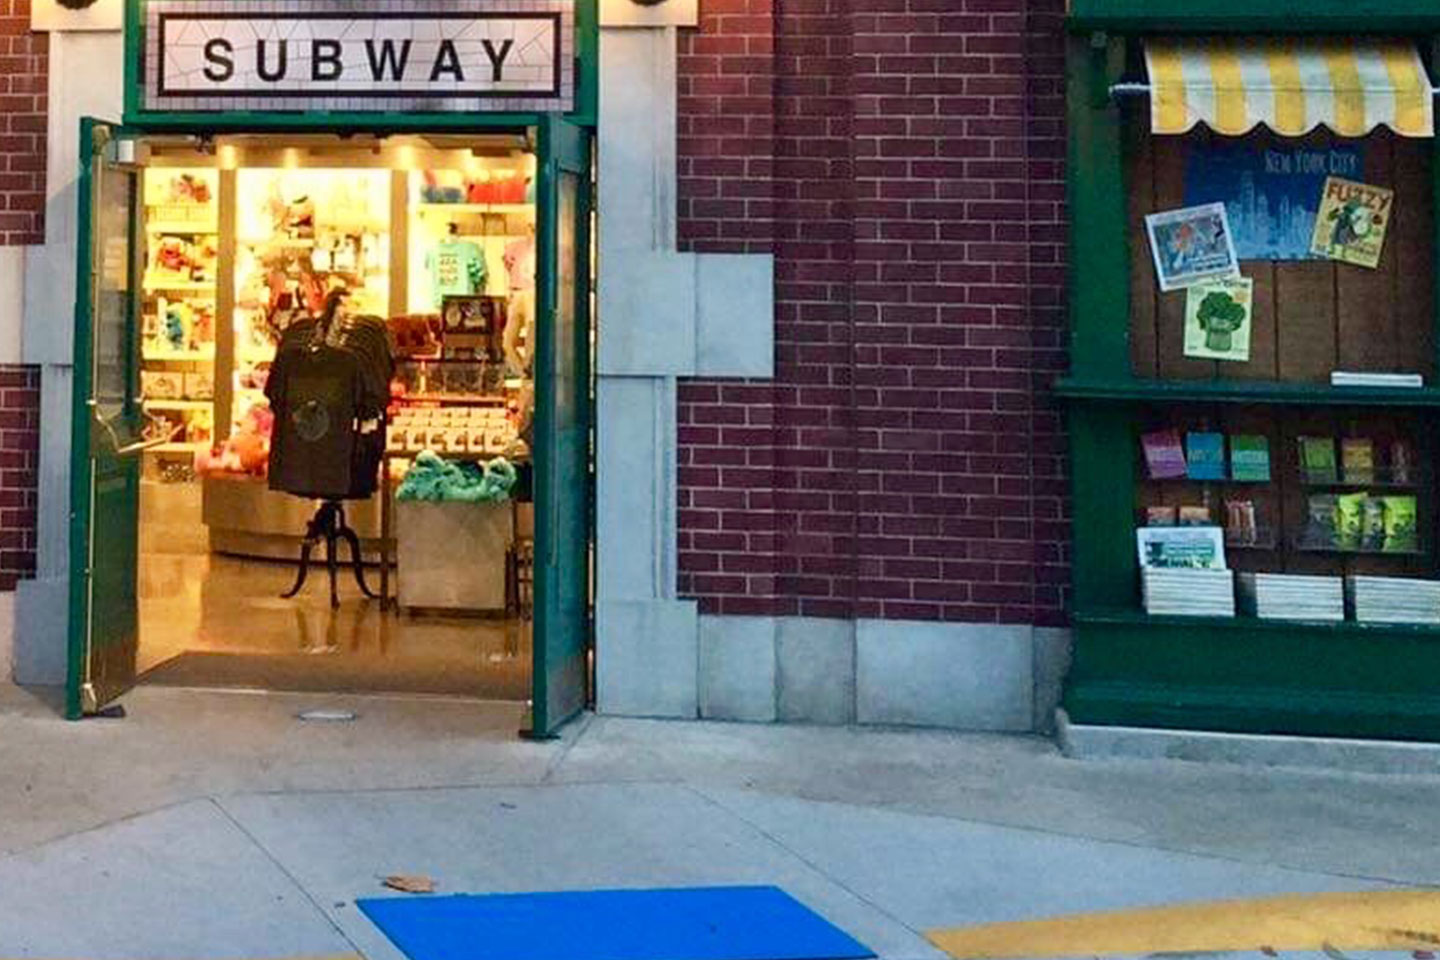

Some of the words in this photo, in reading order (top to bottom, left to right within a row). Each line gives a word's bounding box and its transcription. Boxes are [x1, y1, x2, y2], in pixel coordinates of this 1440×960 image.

[203, 38, 514, 82] SUBWAY
[1265, 152, 1292, 174] NEW
[1295, 151, 1327, 174] YORK
[1327, 183, 1391, 212] FUZZY
